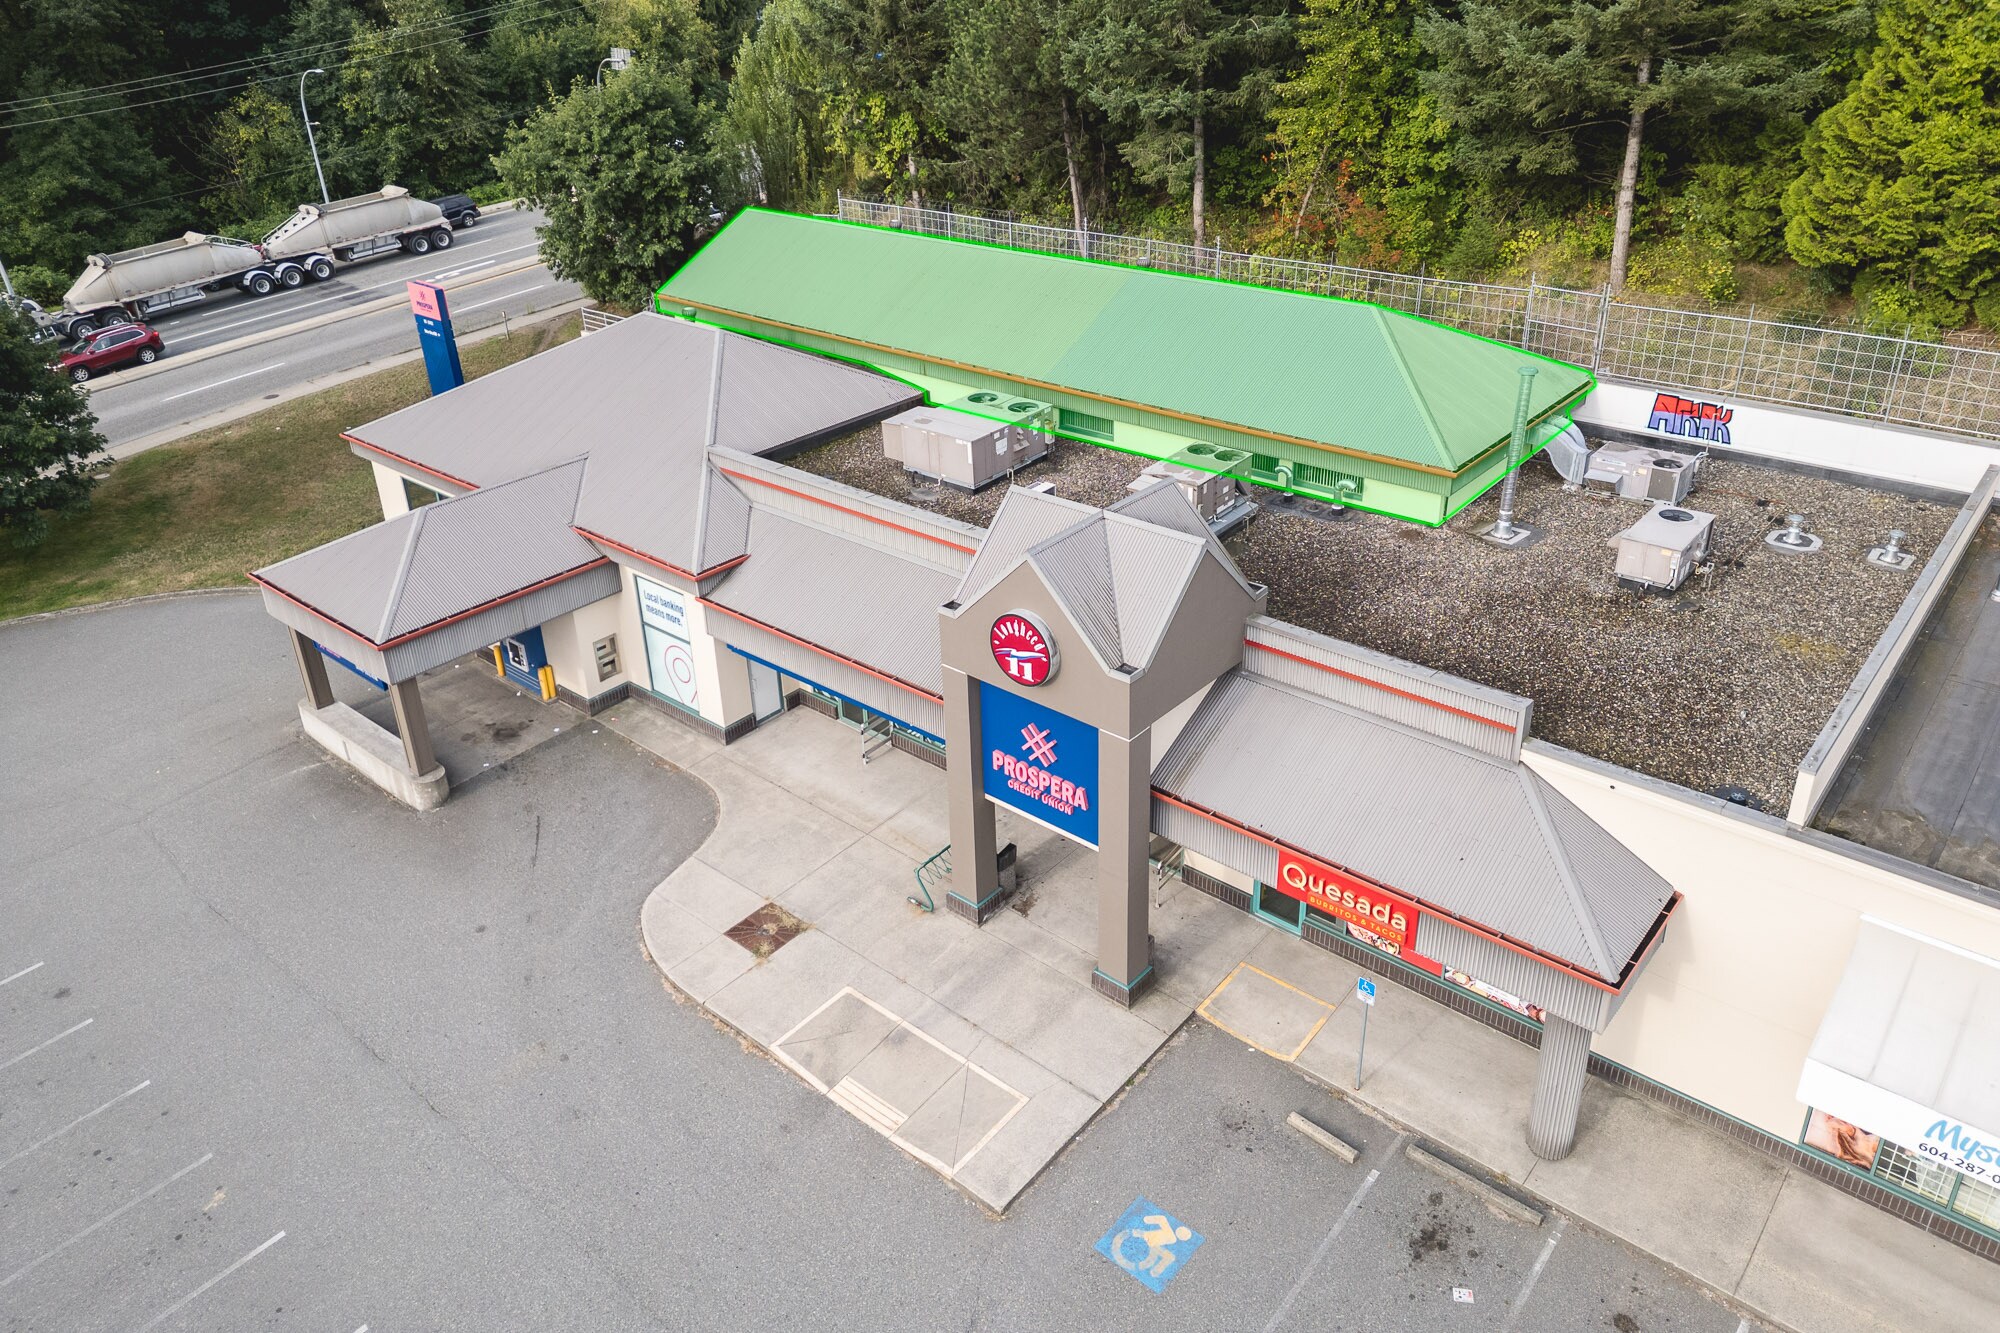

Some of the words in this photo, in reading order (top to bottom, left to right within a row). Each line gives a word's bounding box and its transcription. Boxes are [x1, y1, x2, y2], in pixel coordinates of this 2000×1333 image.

[644, 589, 659, 604] Local
[660, 595, 684, 617] banking
[646, 604, 665, 619] means
[992, 749, 1089, 811] PROSPERA
[1007, 779, 1042, 800] CREDIT
[1041, 793, 1074, 816] UNION
[1282, 861, 1408, 932] Quesada
[1309, 896, 1357, 923] BURRITOS
[1360, 918, 1368, 926] &
[1370, 923, 1403, 942] TACOS
